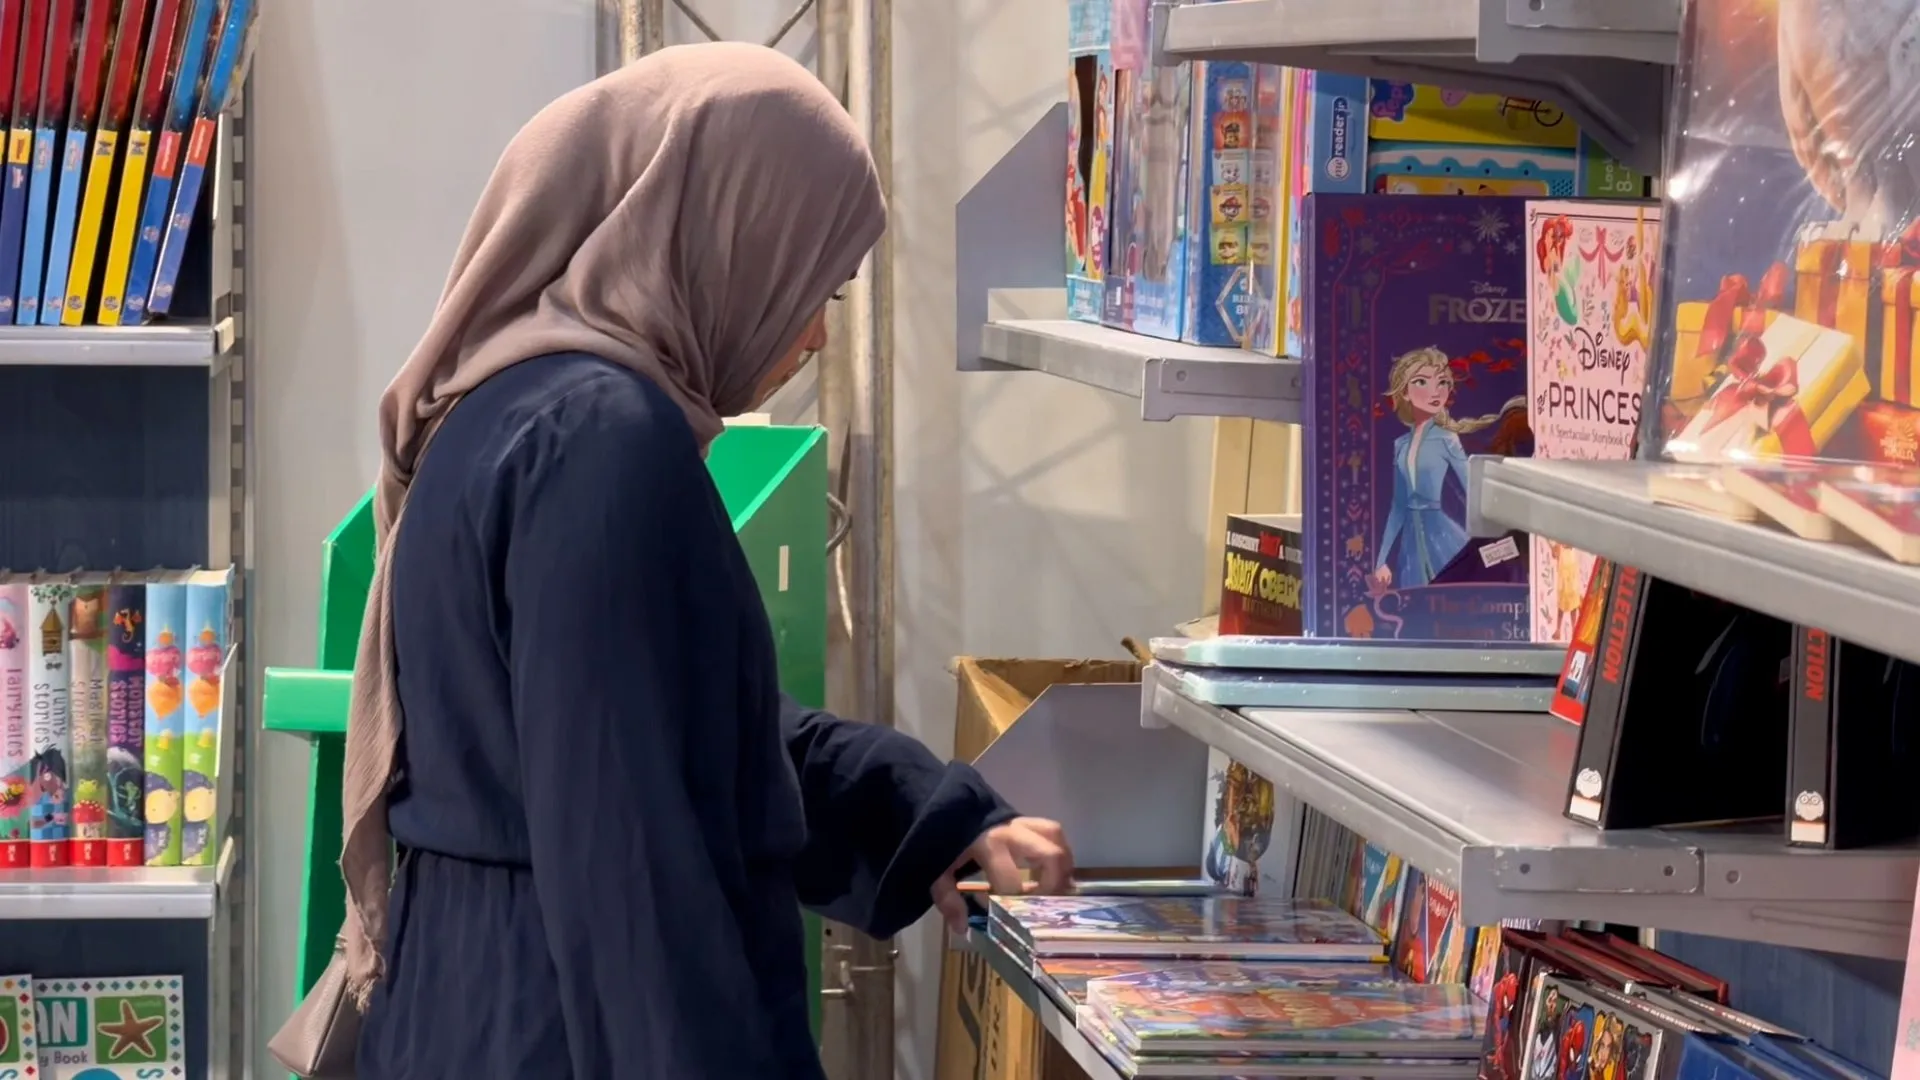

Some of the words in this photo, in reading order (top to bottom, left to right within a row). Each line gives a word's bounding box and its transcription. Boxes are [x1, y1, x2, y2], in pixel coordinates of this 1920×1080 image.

[1333, 114, 1345, 157] reader
[1469, 279, 1508, 297] Disney
[1429, 293, 1525, 325] FROZE
[1549, 381, 1641, 425] PRINCES
[1467, 593, 1529, 621] Compl
[1602, 565, 1640, 684] OLLECTION
[1502, 621, 1529, 640] Sto
[1805, 628, 1827, 701] CTION
[36, 1000, 77, 1044] AN
[54, 1051, 87, 1064] Book
